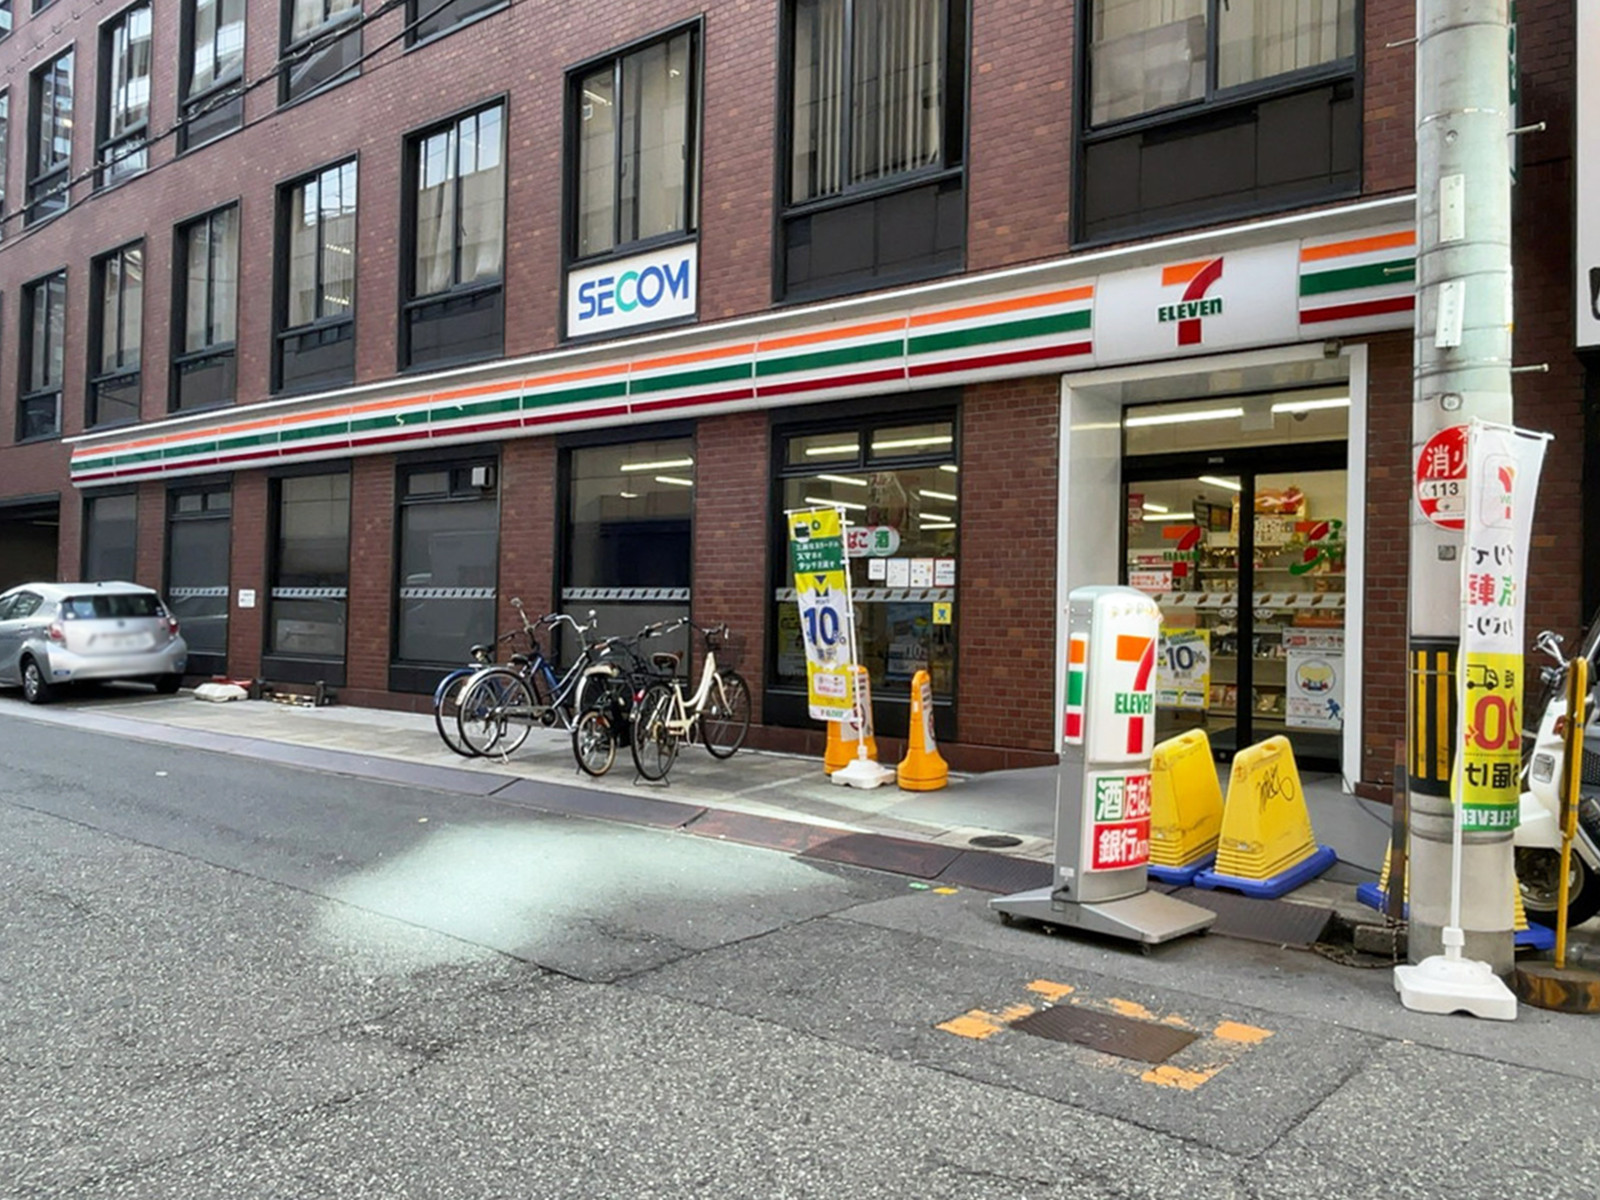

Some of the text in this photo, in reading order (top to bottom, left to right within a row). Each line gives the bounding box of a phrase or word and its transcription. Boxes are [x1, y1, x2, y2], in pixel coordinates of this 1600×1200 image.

[578, 259, 690, 321] SECOM
[1431, 481, 1459, 497] 113
[1097, 780, 1124, 820] 酒
